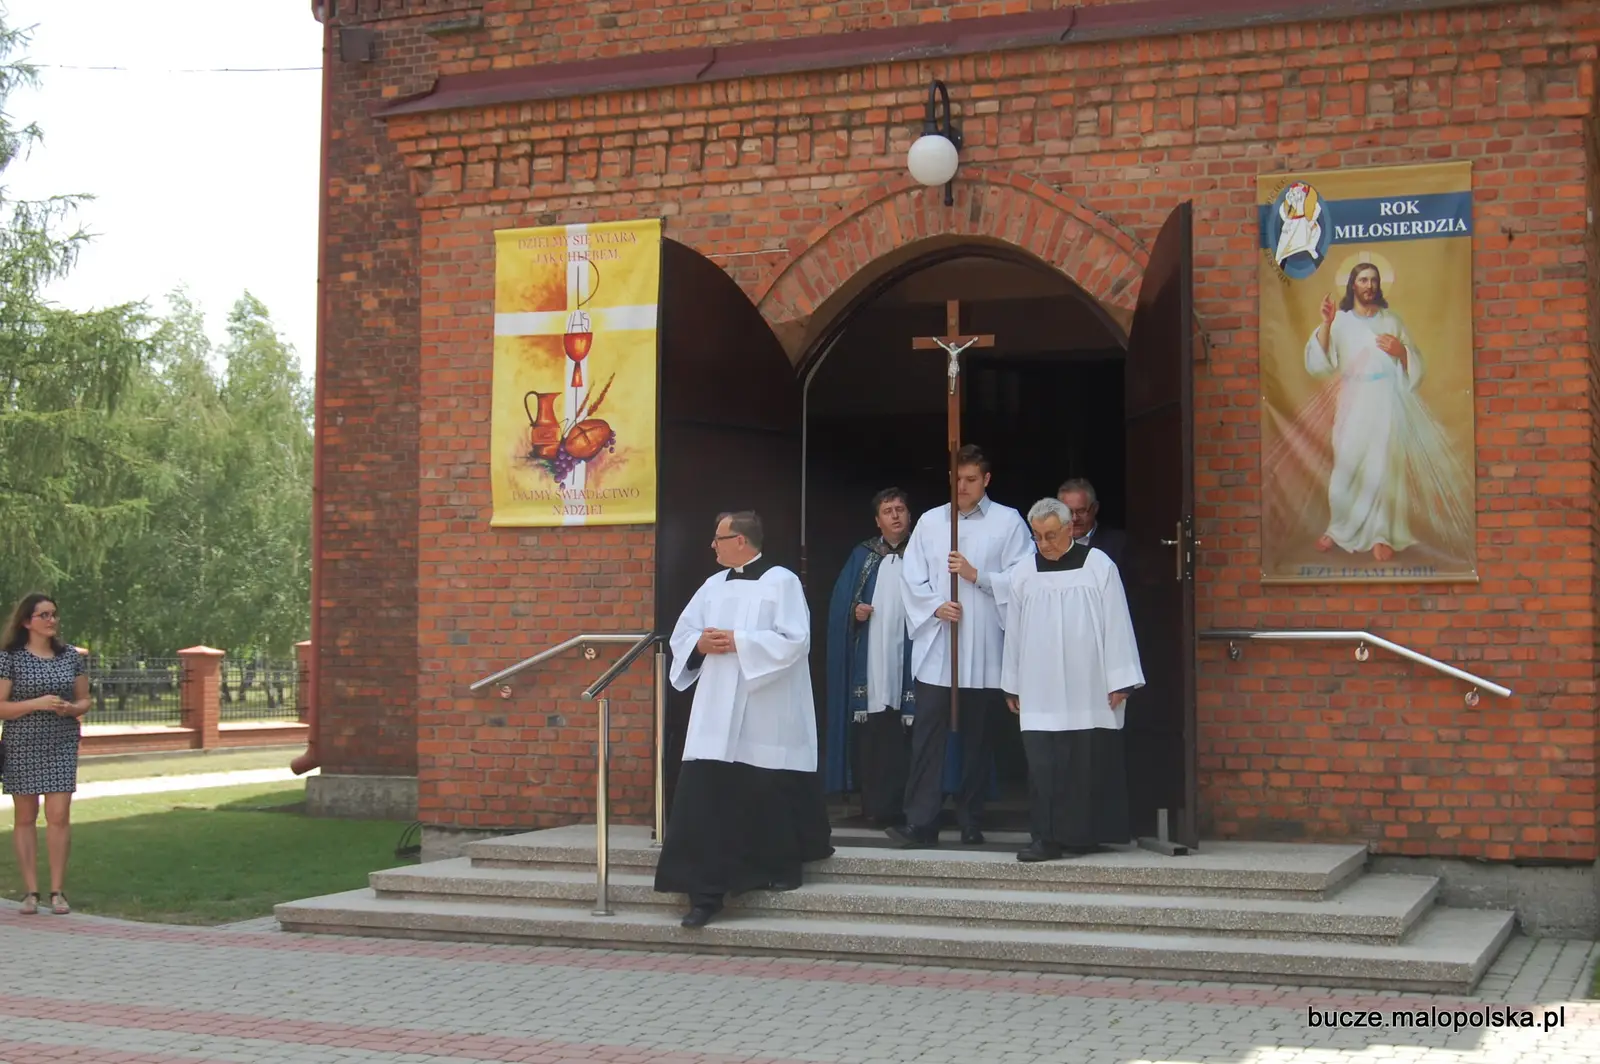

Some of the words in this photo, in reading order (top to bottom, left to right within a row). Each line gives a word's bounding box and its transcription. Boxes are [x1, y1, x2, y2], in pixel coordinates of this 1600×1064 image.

[1380, 200, 1420, 216] ROK
[1334, 218, 1467, 239] MIŁOSIERDZIA
[518, 235, 570, 250] DZIELMY
[535, 253, 556, 265] JAK
[513, 489, 553, 501] DAJMY
[555, 486, 640, 501] ŚWIADECTWO
[553, 503, 603, 516] NADZIEI
